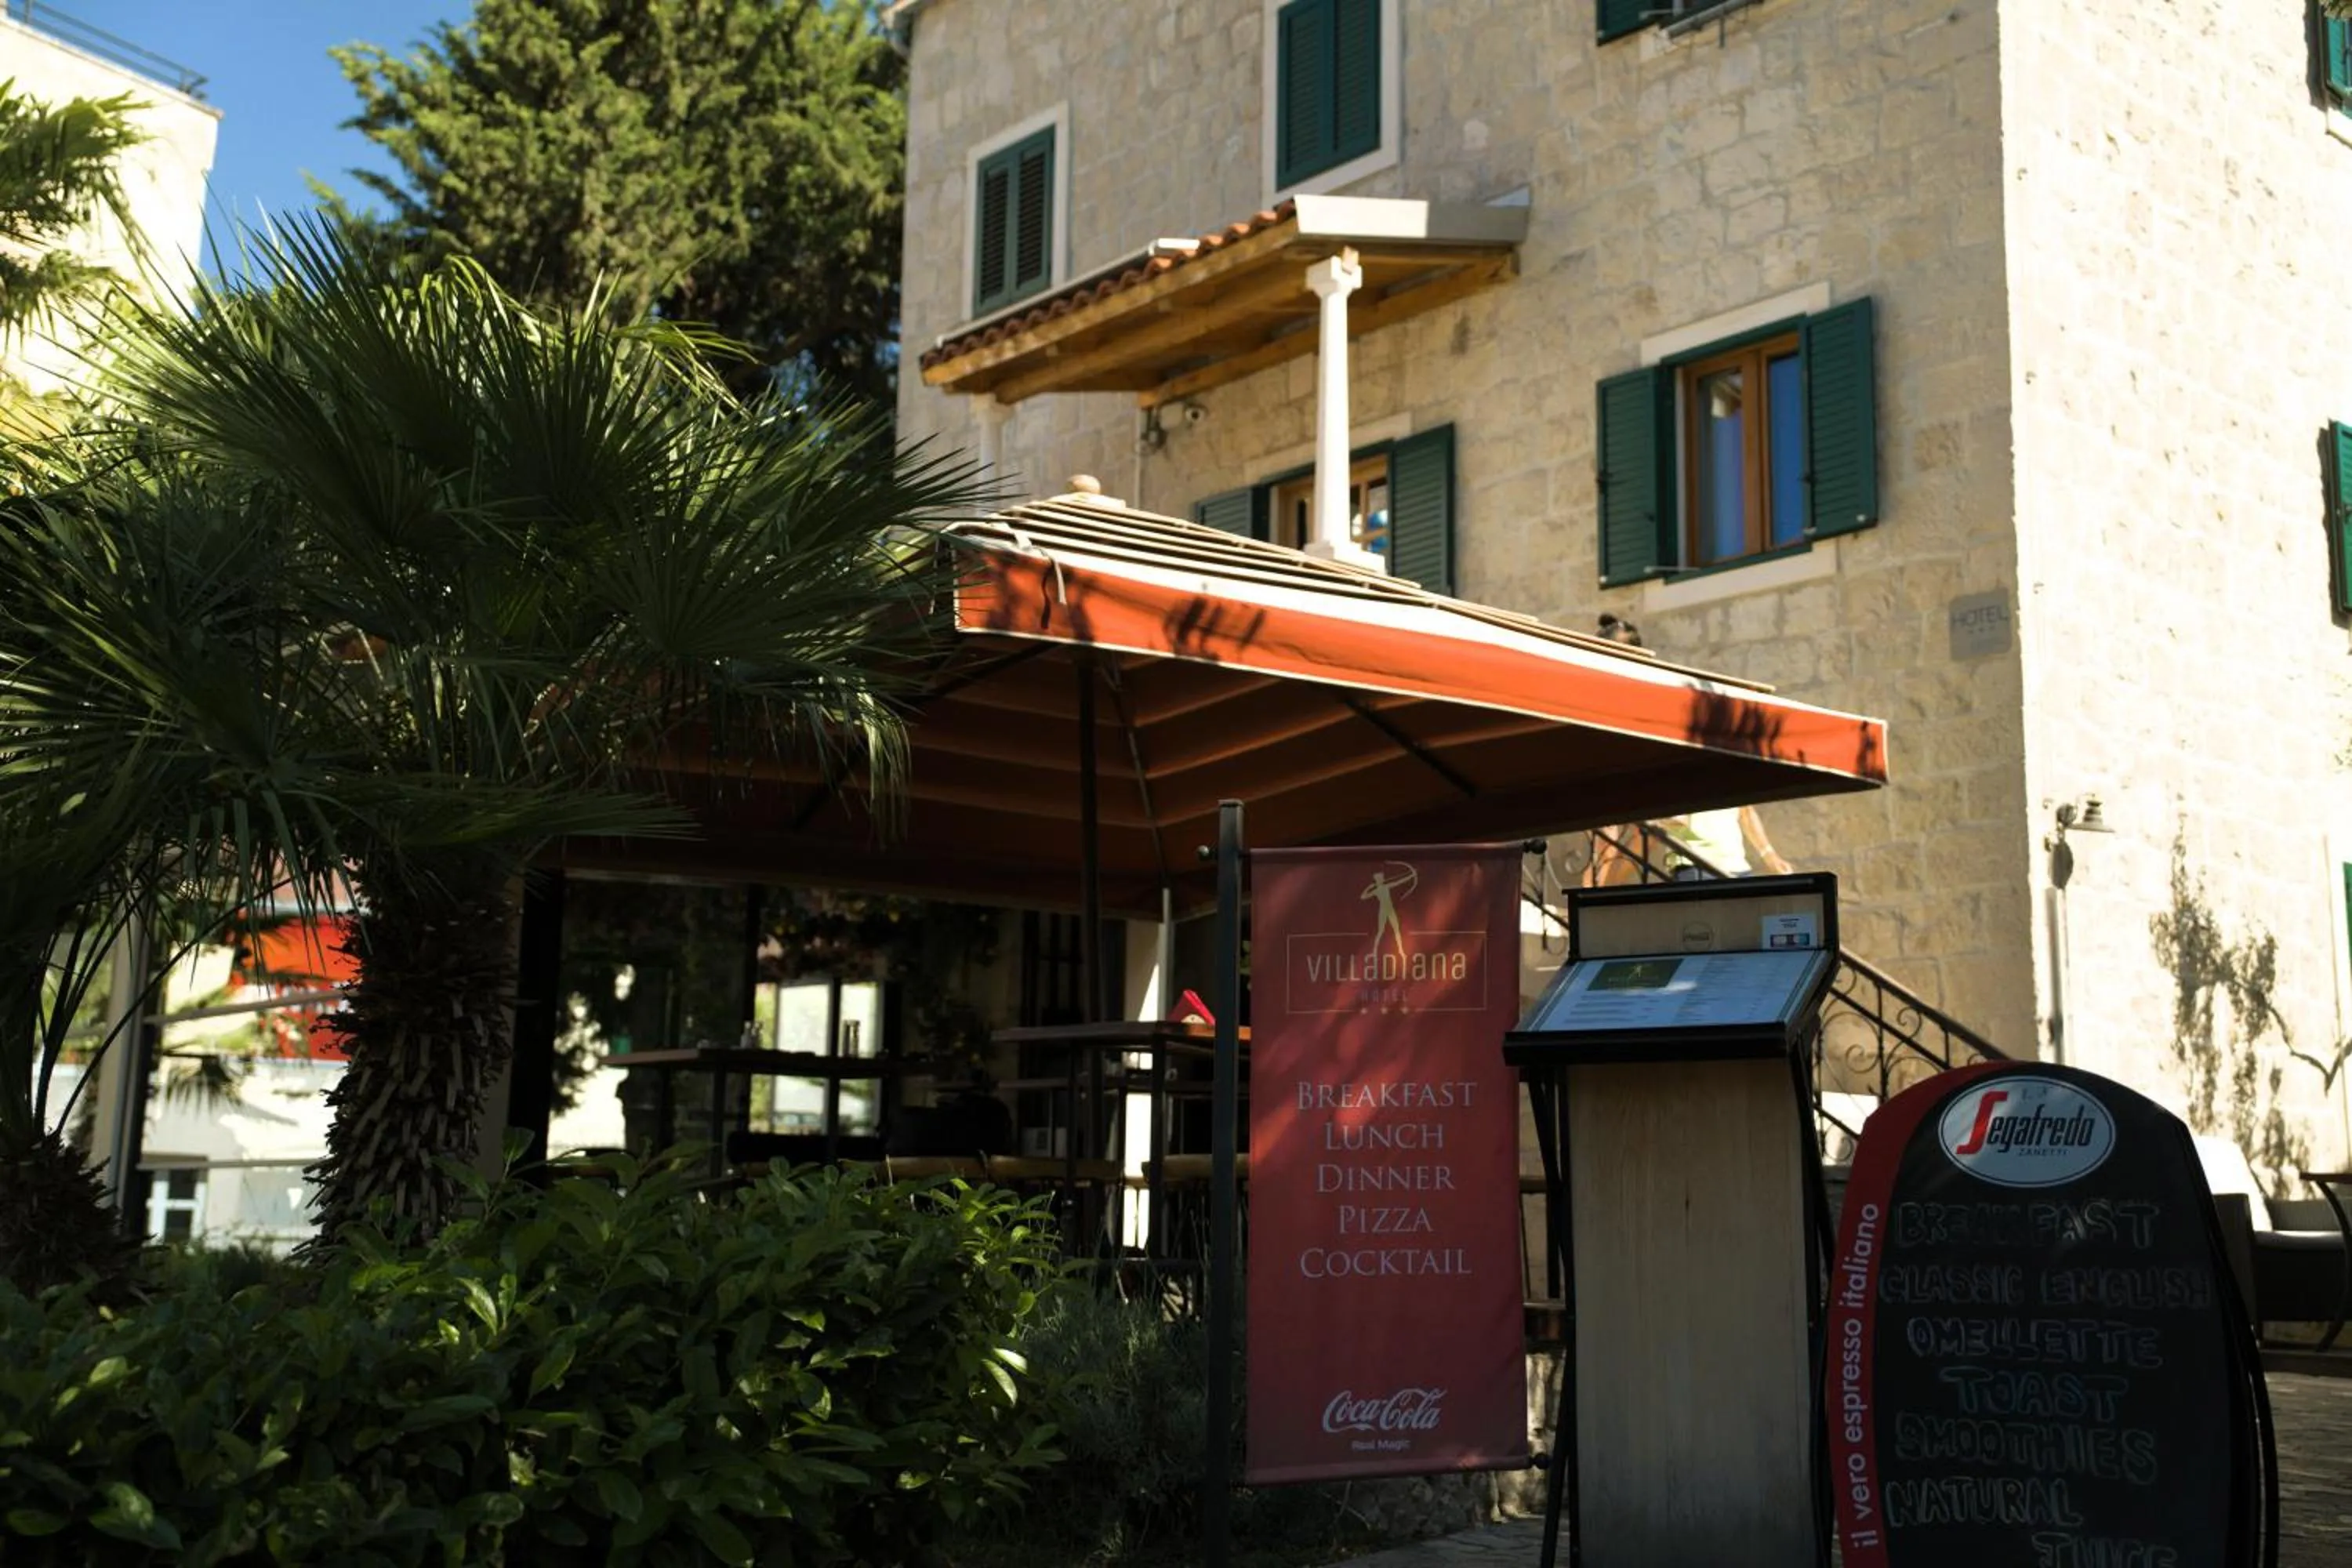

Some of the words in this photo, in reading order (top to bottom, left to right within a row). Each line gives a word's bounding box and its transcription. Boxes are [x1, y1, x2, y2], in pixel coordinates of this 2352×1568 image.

[1951, 604, 2009, 629] HOTEL
[1298, 1082, 1478, 1110] BREAKFAST
[1324, 1123, 1444, 1150] LUNCH
[1955, 1087, 2096, 1154] Segafredo
[1316, 1164, 1455, 1192] DINNER
[1339, 1205, 1433, 1234] PIZZA
[1300, 1247, 1472, 1279] COCKTAIL
[1838, 1203, 1879, 1308] italiano
[1879, 1264, 2025, 1306] CLASSIC
[2040, 1265, 2212, 1310] ENGLISH
[1842, 1318, 1868, 1443] espresso
[1938, 1365, 2129, 1423] TOAST
[1322, 1388, 1448, 1432] Coca-Cola
[1894, 1410, 2159, 1486] SMOOTHIES
[1847, 1453, 1873, 1520] vero
[1884, 1475, 2084, 1528] NATURAL
[1849, 1530, 1879, 1548] il
